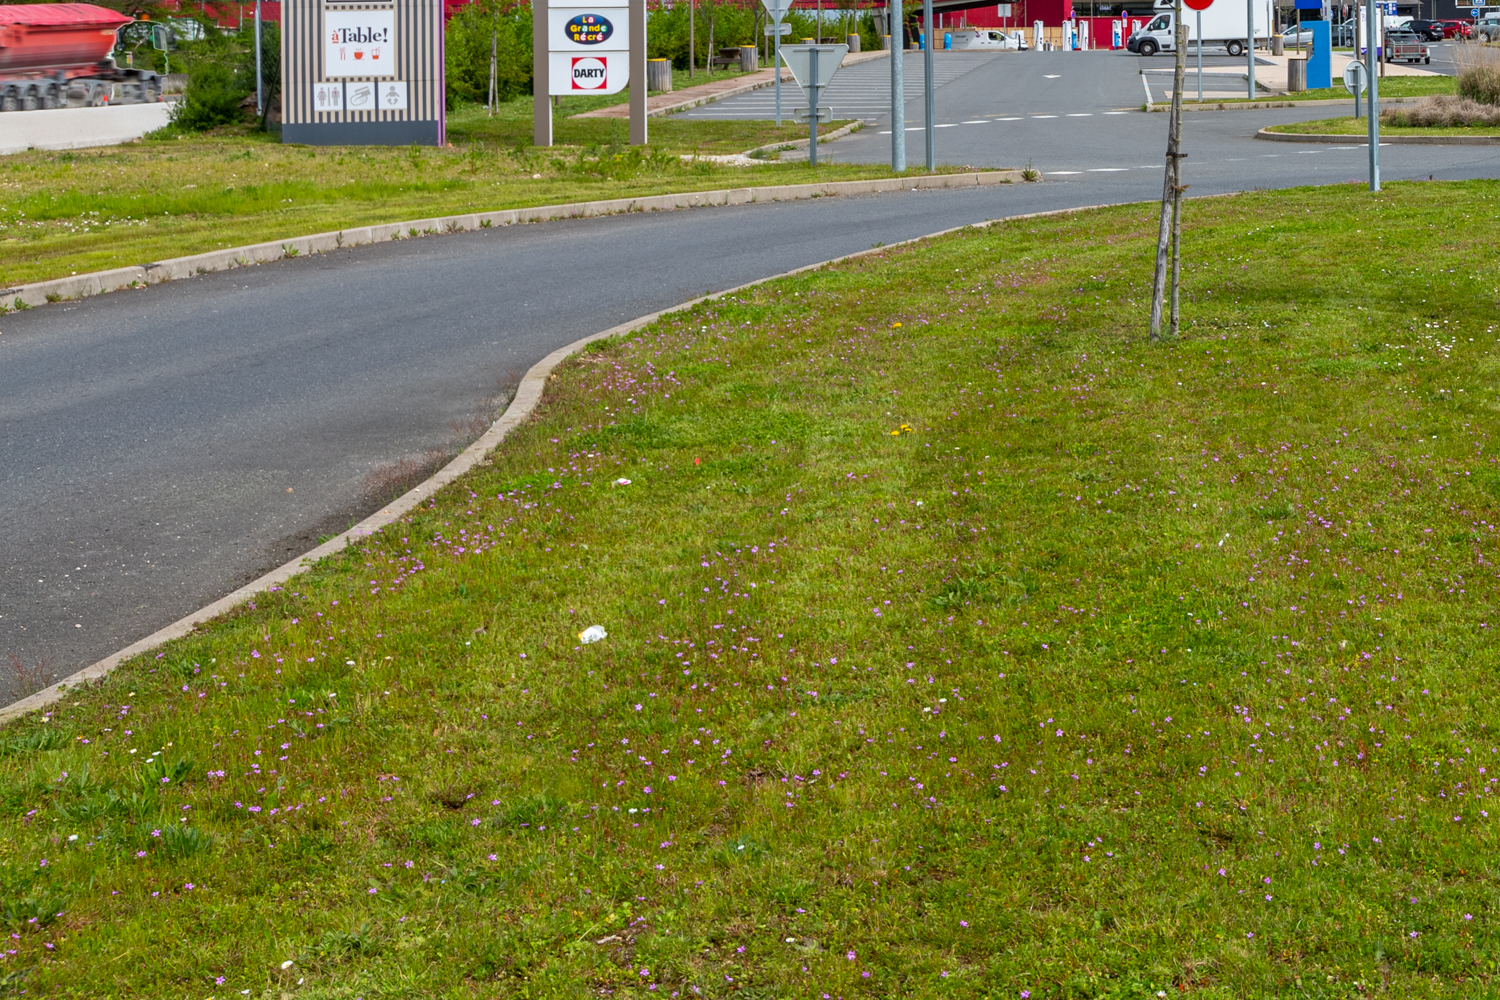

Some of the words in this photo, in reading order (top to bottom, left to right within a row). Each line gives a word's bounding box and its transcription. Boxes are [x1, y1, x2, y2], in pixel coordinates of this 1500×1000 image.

[582, 16, 595, 24] La
[570, 24, 607, 32] Grande
[574, 32, 604, 41] Récré
[574, 68, 605, 78] DARTY
